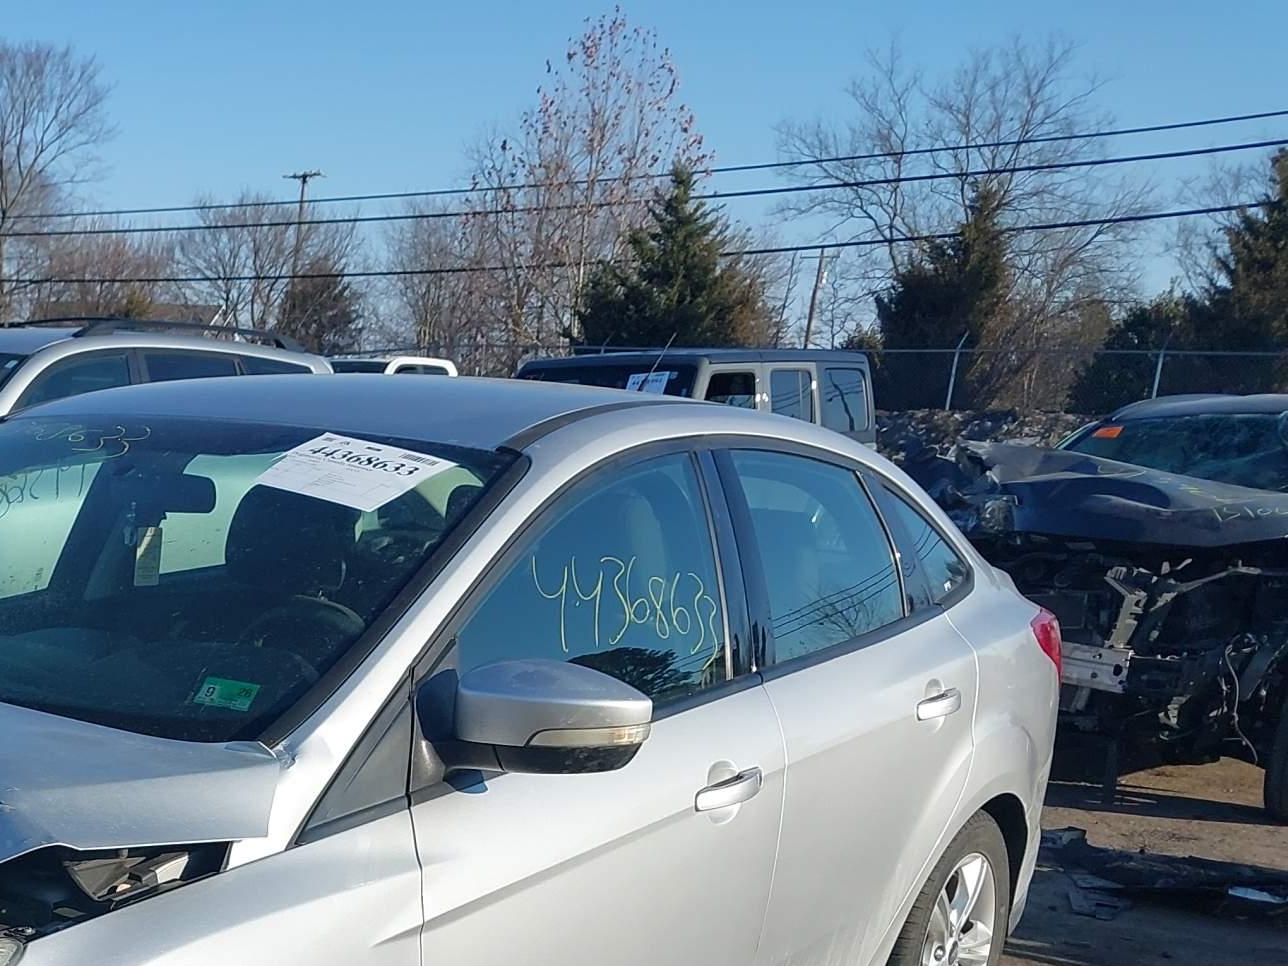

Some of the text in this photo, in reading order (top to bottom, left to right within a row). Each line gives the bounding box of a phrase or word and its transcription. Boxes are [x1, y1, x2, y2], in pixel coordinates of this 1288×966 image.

[309, 445, 420, 477] 44368633
[532, 555, 719, 671] 44368633
[204, 686, 216, 698] 9
